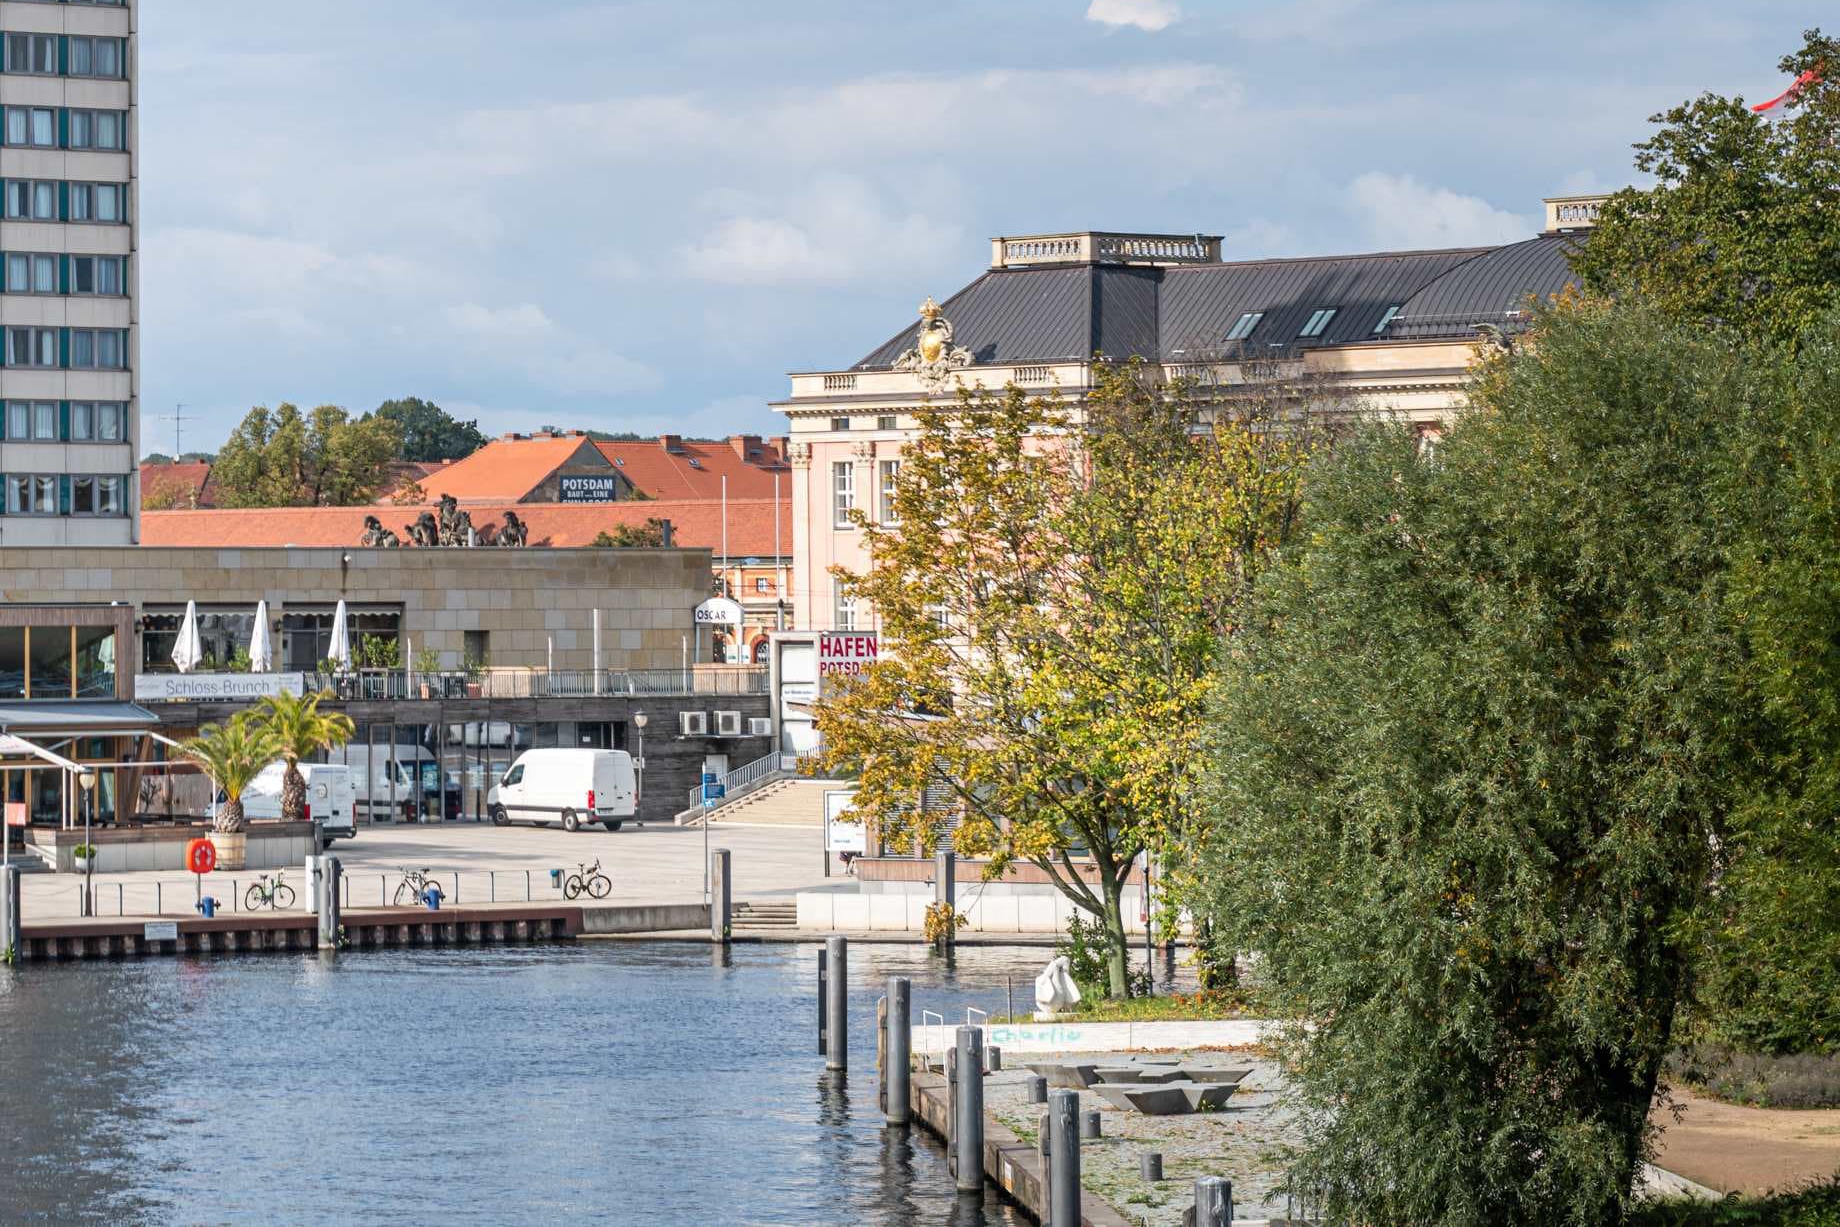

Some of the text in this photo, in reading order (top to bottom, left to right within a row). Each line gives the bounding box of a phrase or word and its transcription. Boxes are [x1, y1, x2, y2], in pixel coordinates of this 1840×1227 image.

[562, 478, 613, 490] POTSDAM
[697, 610, 727, 620] OSCAR
[820, 637, 877, 657] HAFEN
[820, 661, 877, 676] POTSD
[165, 679, 270, 695] Schloss-Brunch
